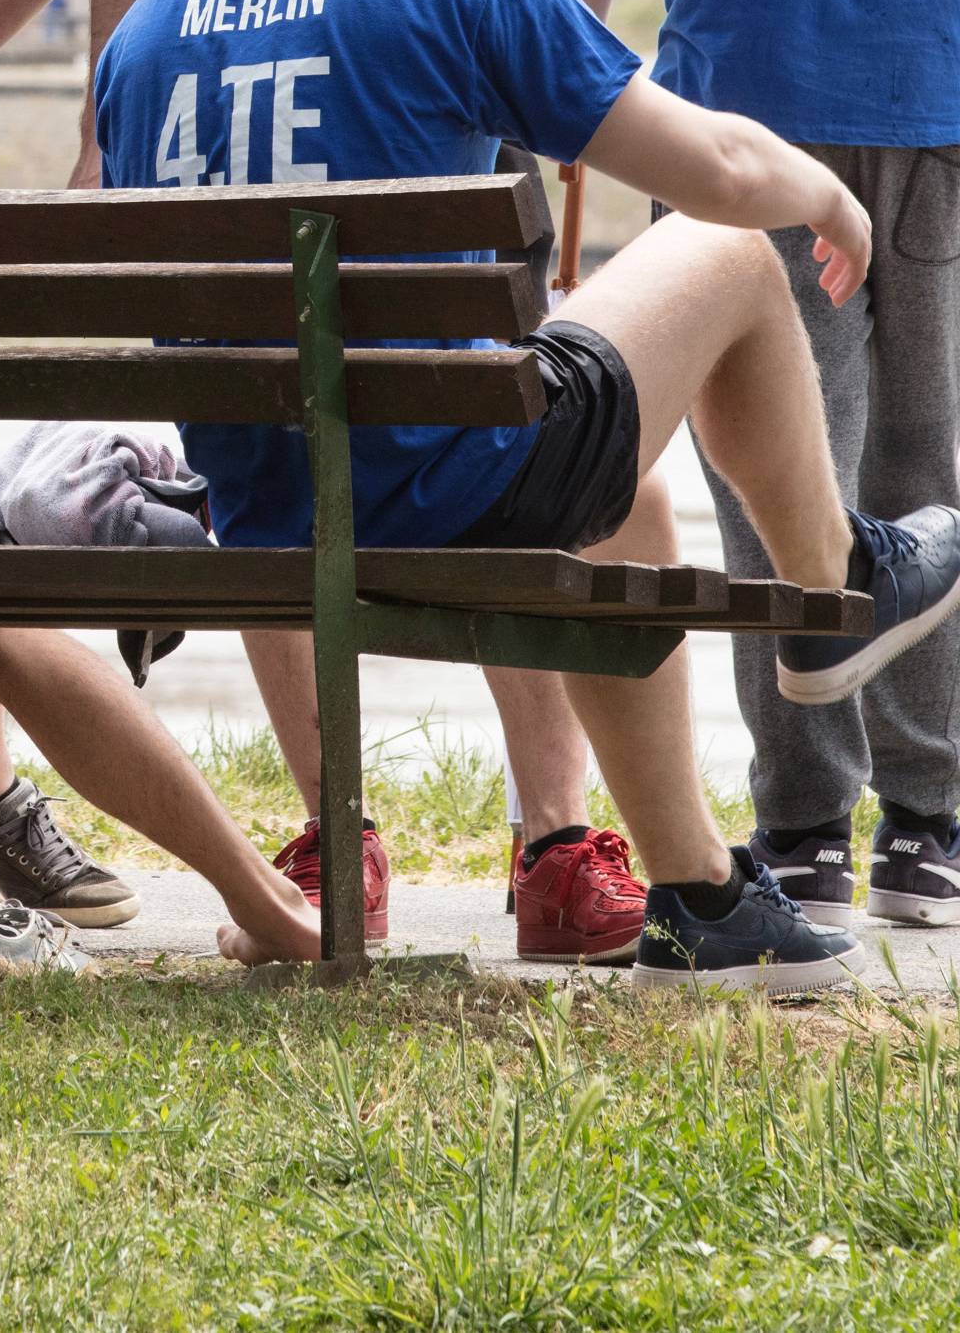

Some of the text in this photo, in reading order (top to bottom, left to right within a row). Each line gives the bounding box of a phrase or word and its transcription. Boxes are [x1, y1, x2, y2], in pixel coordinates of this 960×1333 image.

[156, 56, 330, 187] 4.TE
[890, 839, 921, 854] NIKE
[815, 850, 844, 863] NIKE
